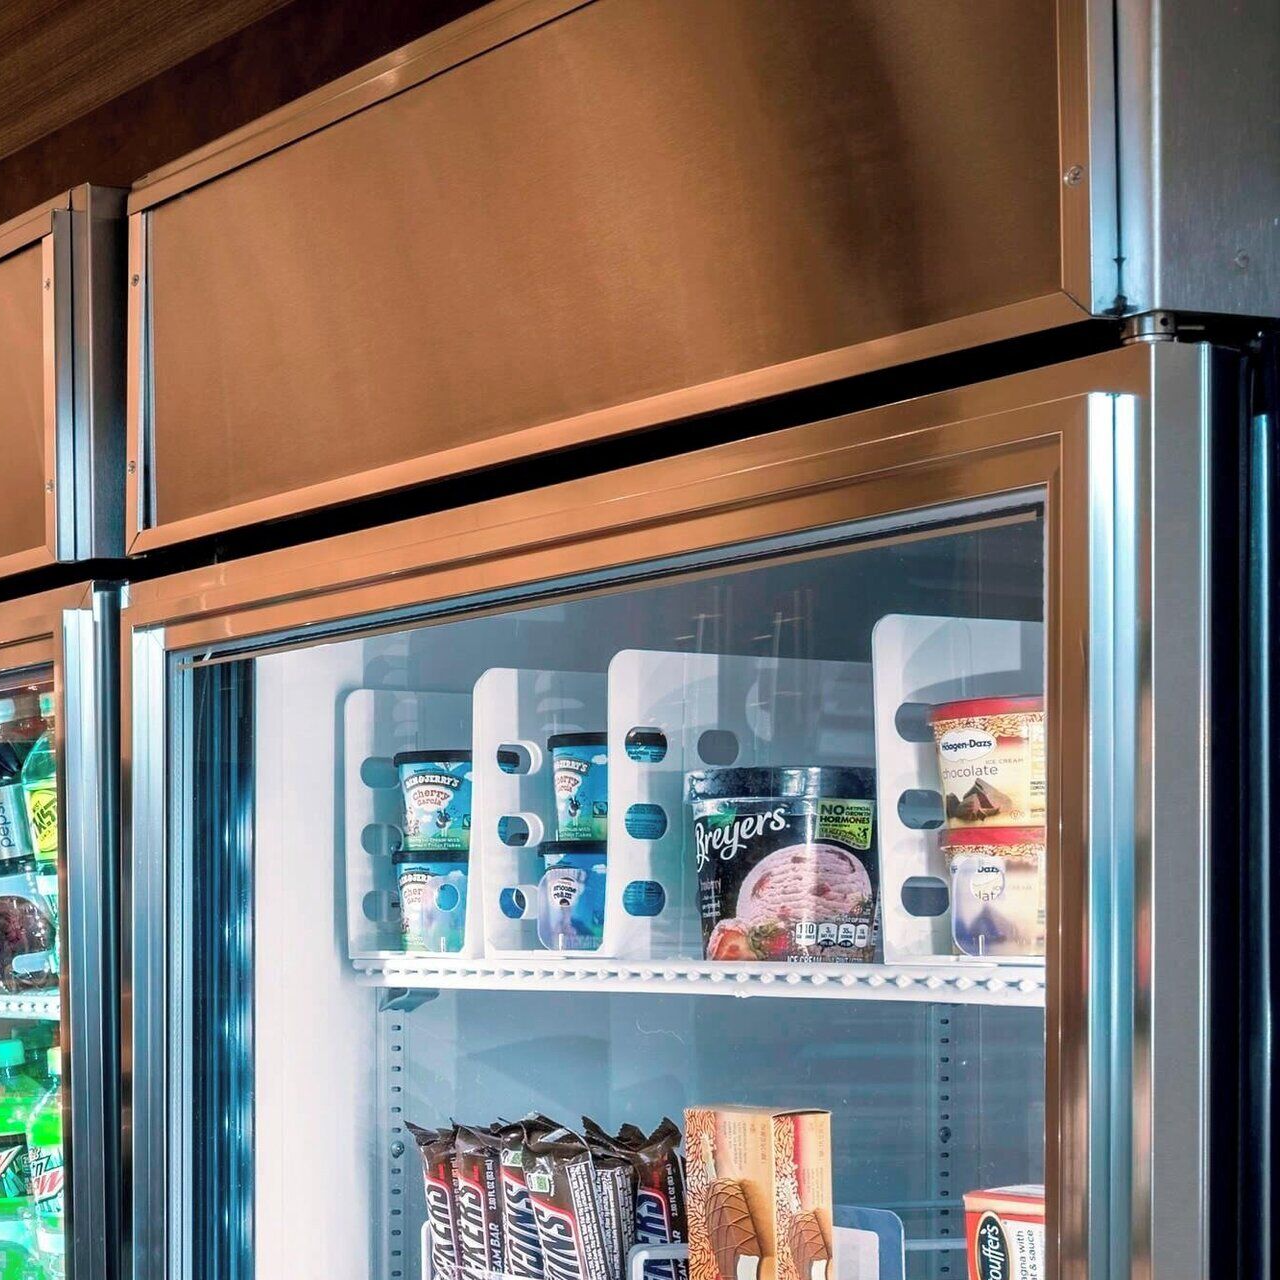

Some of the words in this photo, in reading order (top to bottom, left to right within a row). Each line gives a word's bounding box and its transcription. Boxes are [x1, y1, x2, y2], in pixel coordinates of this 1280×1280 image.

[413, 788, 450, 801] Cherry
[821, 804, 844, 814] NO
[820, 816, 871, 824] HORMONES
[1019, 1229, 1027, 1255] with
[1028, 1228, 1037, 1268] sauce
